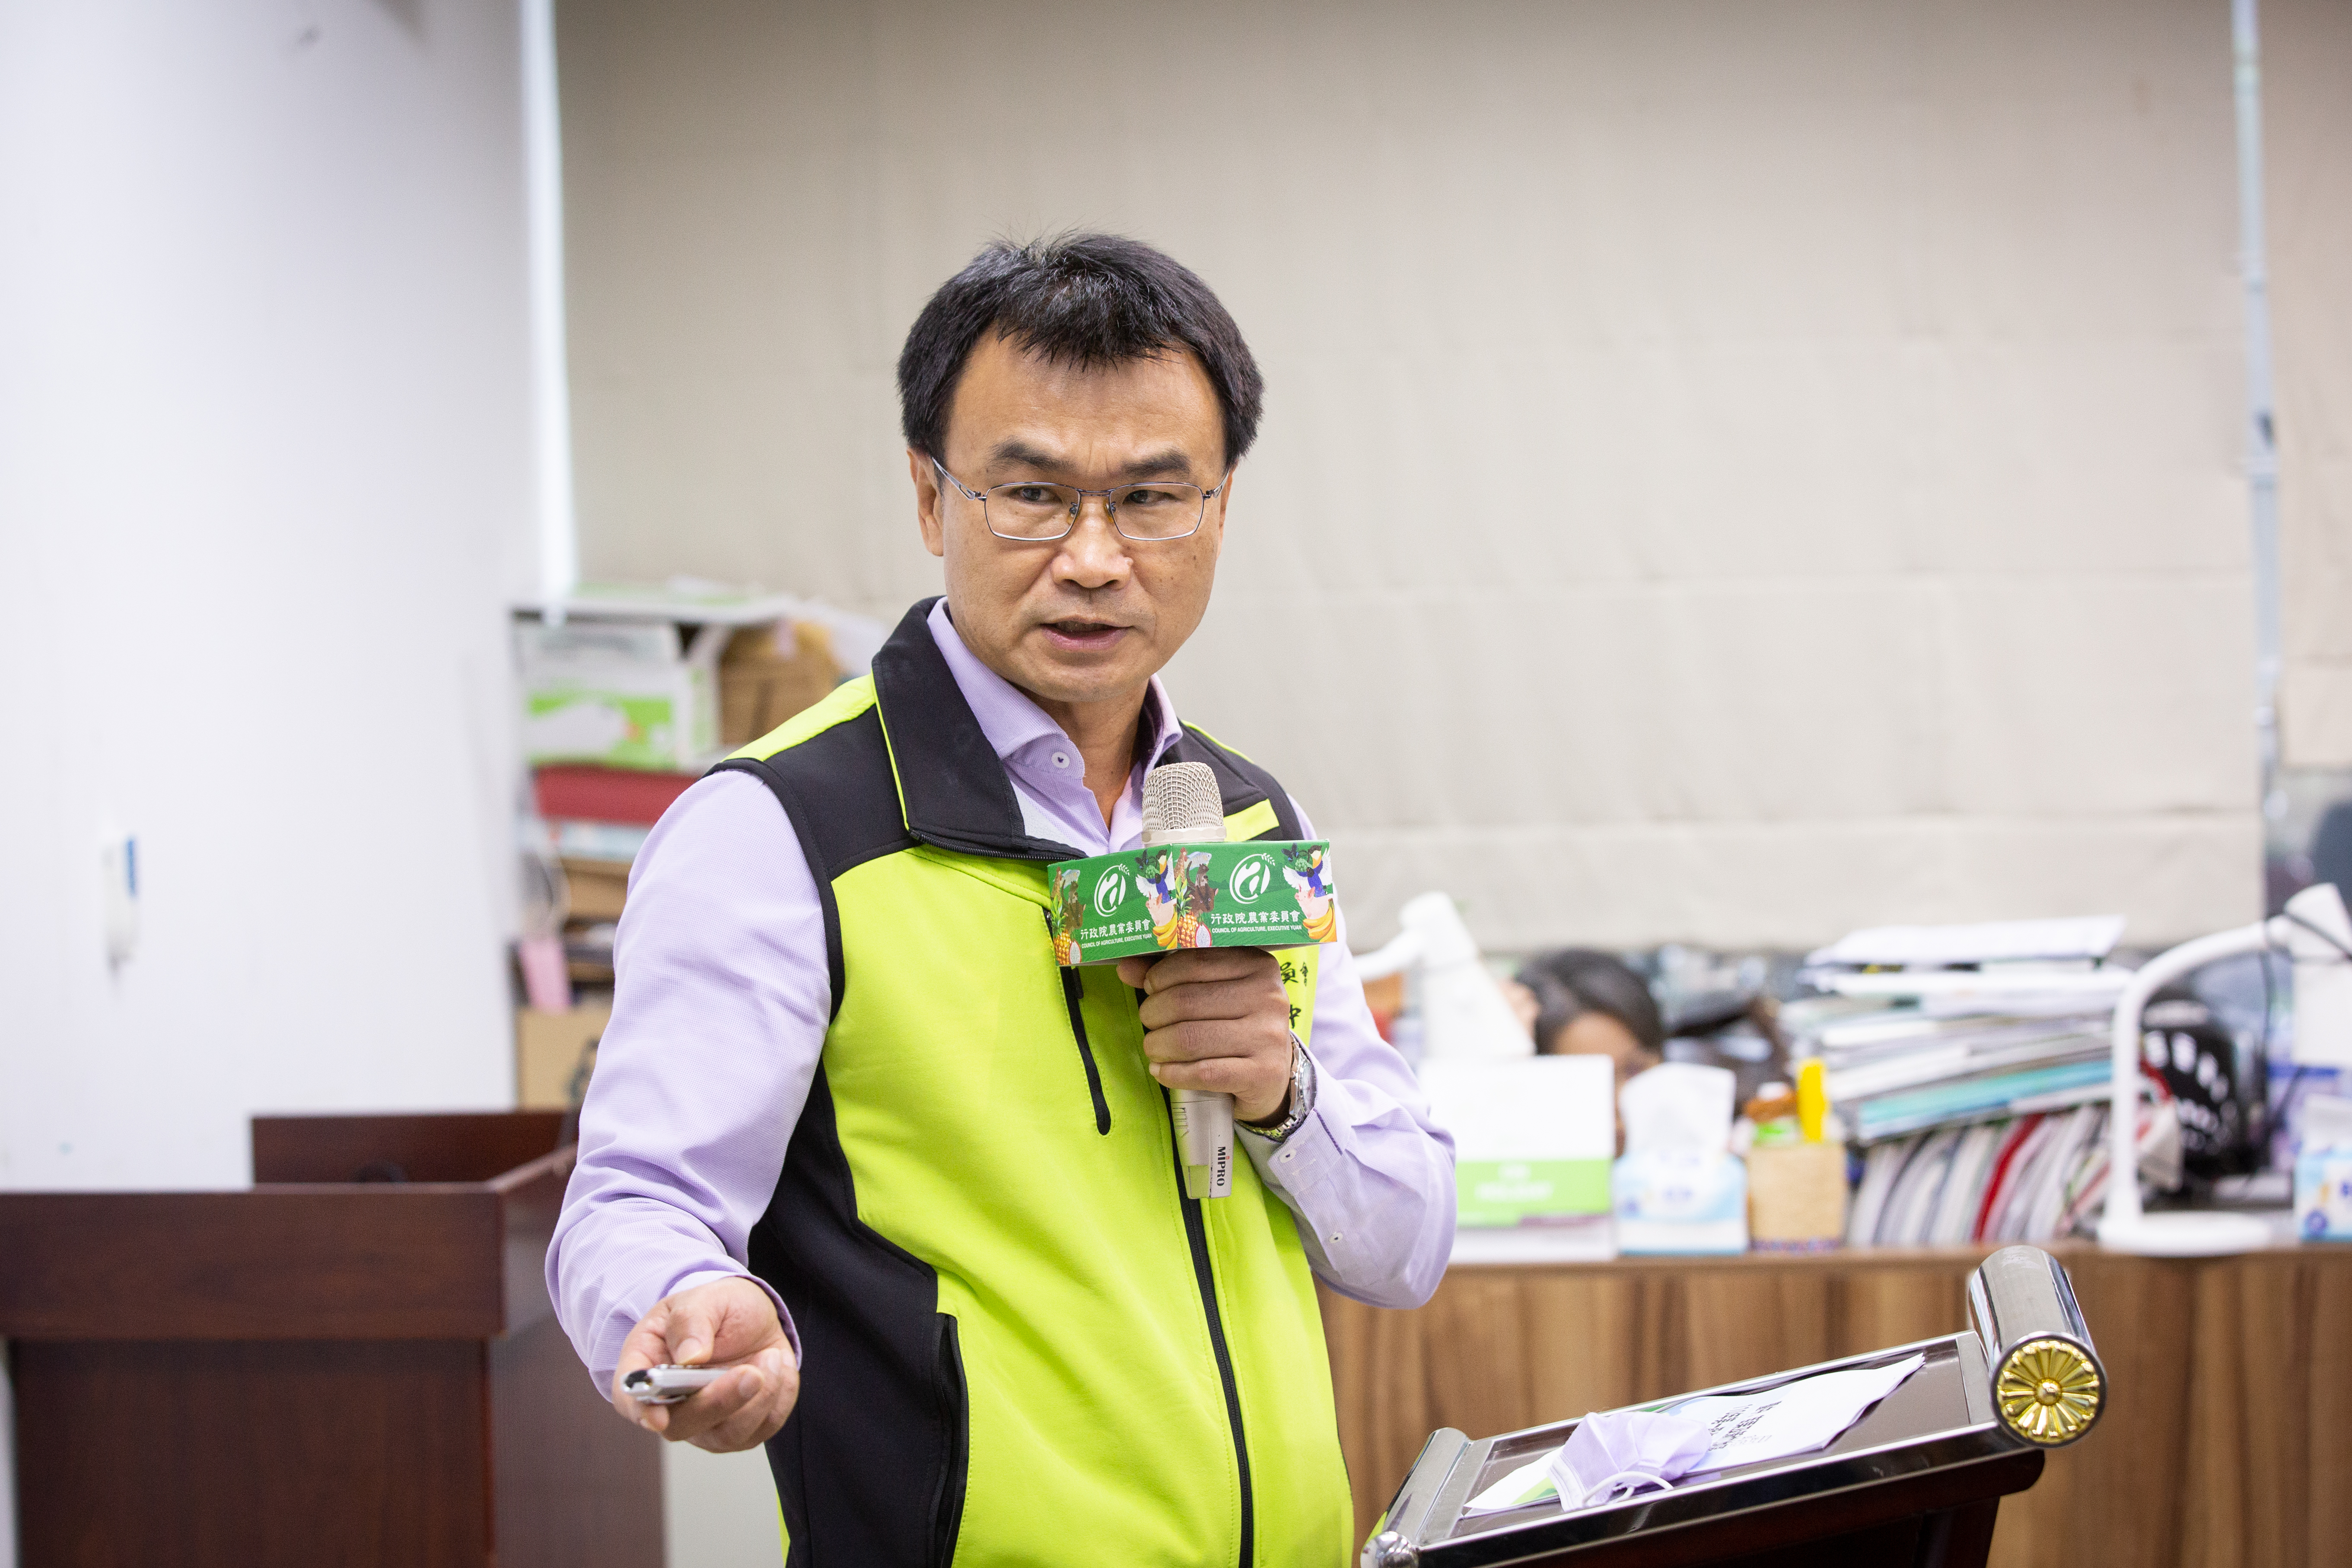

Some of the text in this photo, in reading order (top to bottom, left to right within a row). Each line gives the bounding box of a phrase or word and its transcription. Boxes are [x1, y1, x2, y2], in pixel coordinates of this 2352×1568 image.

[1210, 910, 1301, 925] 行政院農業委員會
[1080, 918, 1151, 940] 行政院農業委員會
[1216, 1146, 1226, 1186] MIPRO
